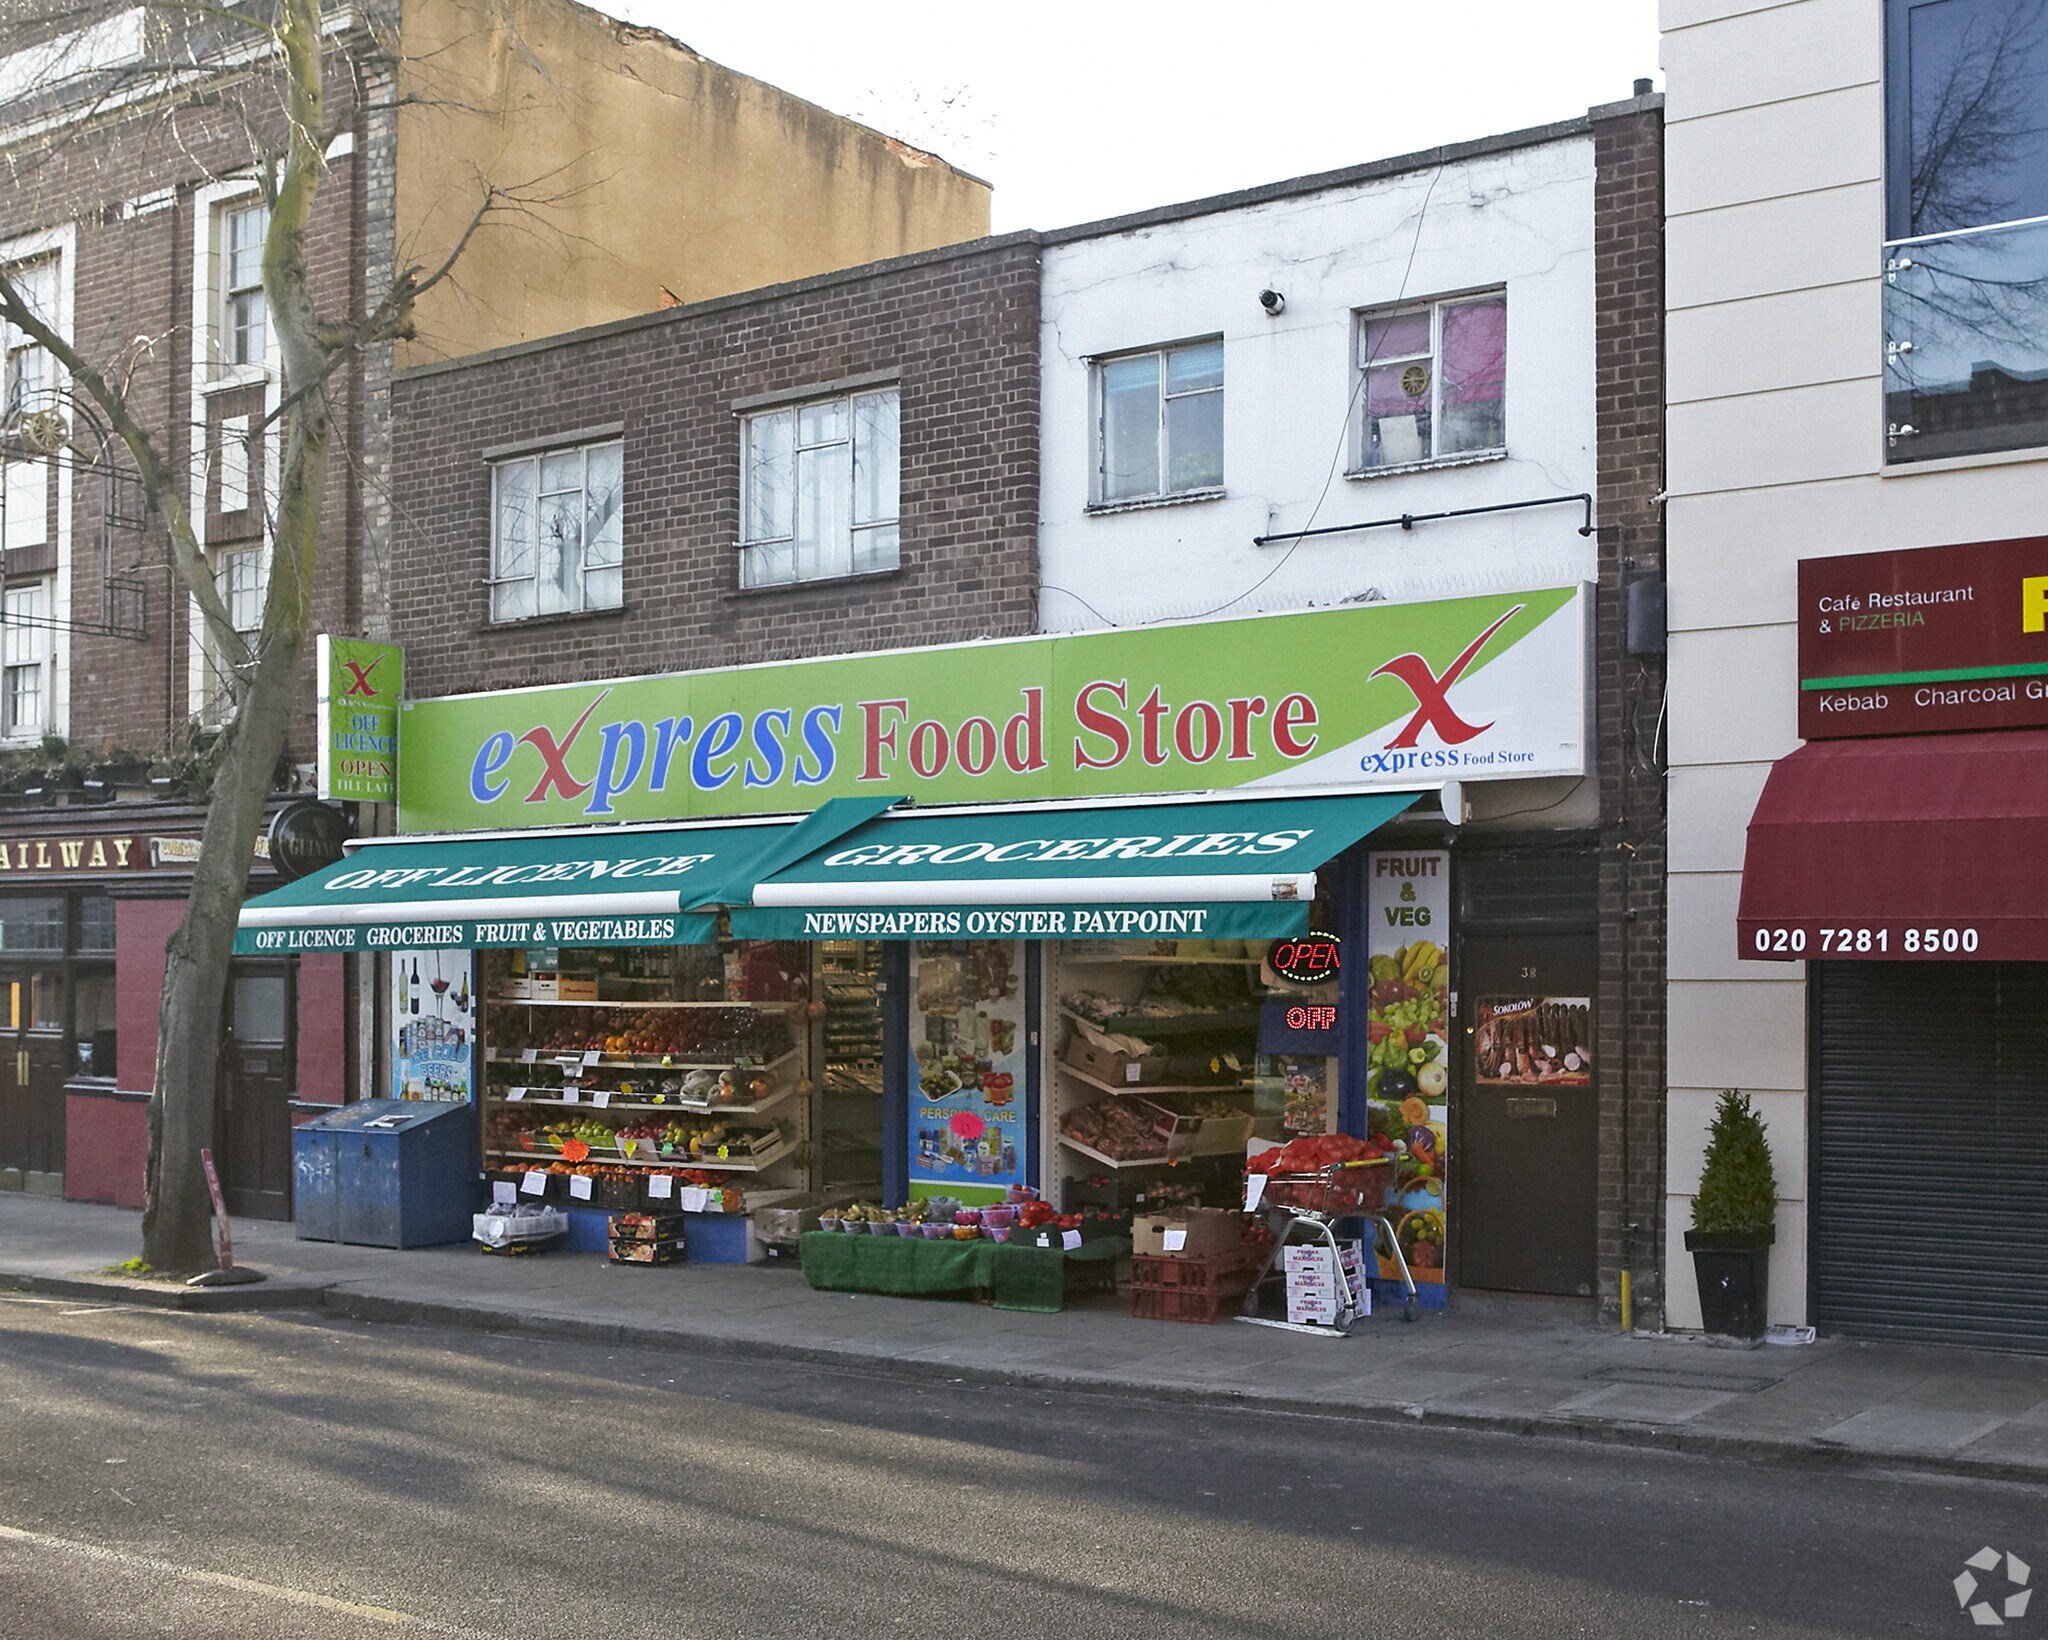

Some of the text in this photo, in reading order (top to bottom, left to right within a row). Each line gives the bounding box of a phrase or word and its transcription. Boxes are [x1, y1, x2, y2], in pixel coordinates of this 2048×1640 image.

[1819, 585, 1974, 612] Café Restaurant
[1819, 611, 1925, 634] & PIZZERIA
[1820, 691, 1889, 712] Kebab
[1914, 683, 2016, 706] Charcoal
[352, 714, 380, 732] OFF
[856, 687, 1048, 781] Food
[1073, 678, 1319, 771] Store
[335, 732, 398, 754] LICENCE
[340, 759, 391, 777] OPEN
[1463, 751, 1495, 766] Food
[1498, 750, 1535, 764] Store
[337, 779, 398, 793] TILL LATE
[823, 829, 1313, 867] GROCERIES
[324, 854, 715, 890] OFF LICENCE
[1376, 857, 1441, 877] FRUIT
[1400, 882, 1416, 902] &
[804, 909, 1207, 934] NEWSPAPERS OYSTER PAYPOINT
[1384, 906, 1431, 926] VEG
[256, 919, 675, 948] OFF LICENCE GROCERIES FRUIT & VEGETABLES
[1755, 928, 1979, 952] 020 7281 8500
[1286, 1006, 1336, 1030] OFF
[409, 1044, 470, 1065] ICE COLD
[420, 1063, 453, 1082] BEERS
[920, 1107, 1016, 1123] PERSO CARE
